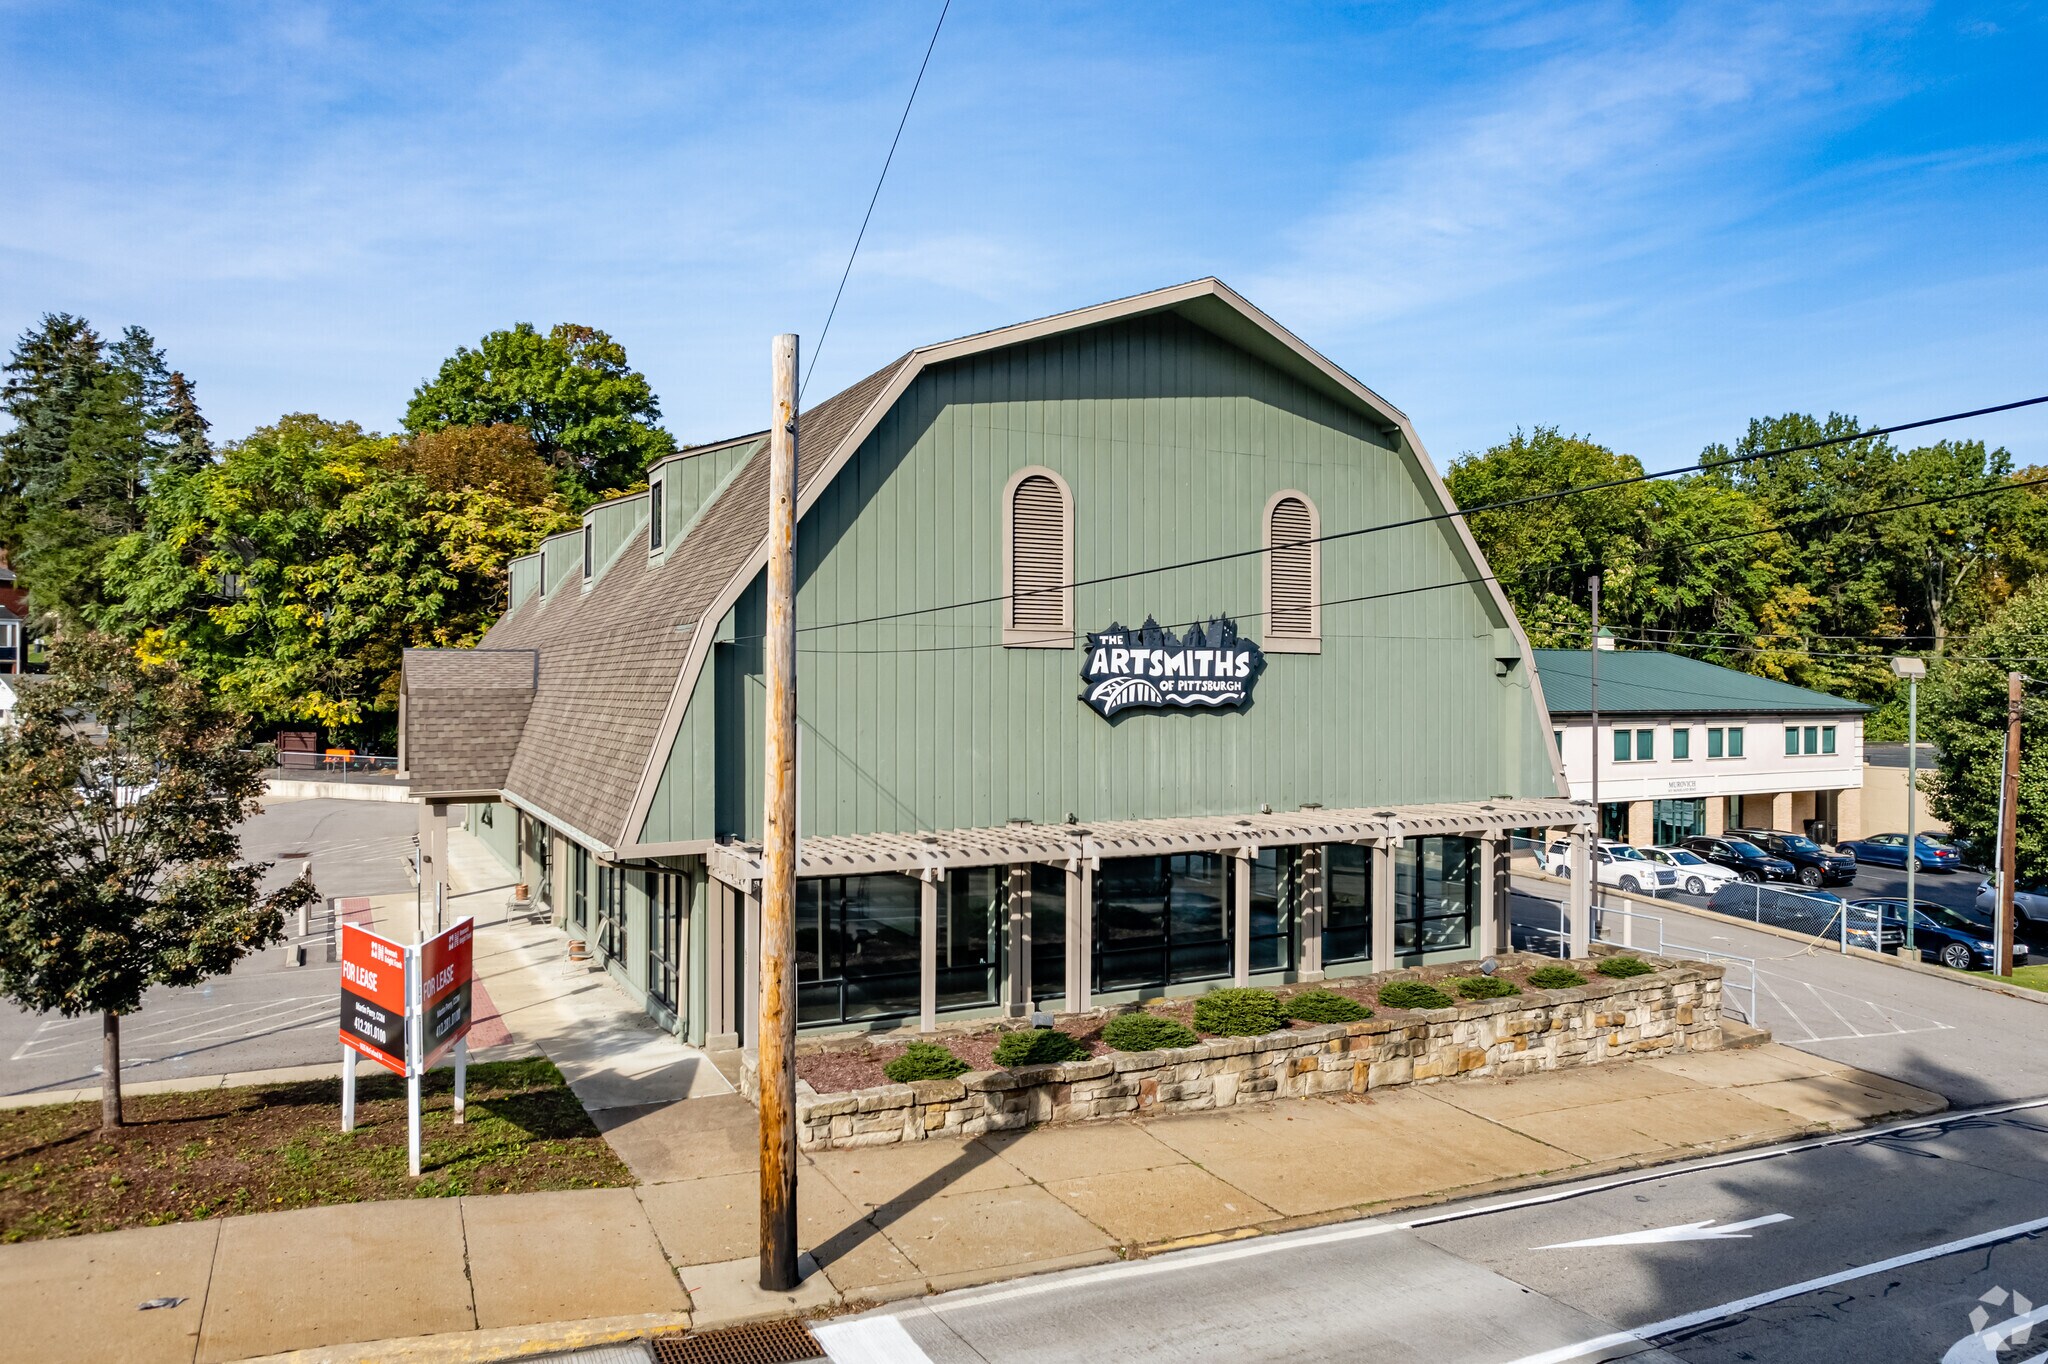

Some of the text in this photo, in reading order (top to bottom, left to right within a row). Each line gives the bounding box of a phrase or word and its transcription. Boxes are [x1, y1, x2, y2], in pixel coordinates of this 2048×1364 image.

[1099, 635, 1124, 644] THE
[1090, 648, 1250, 677] ARTSMITHS
[1160, 680, 1242, 692] OF PITTSBURGH
[343, 960, 378, 992] FOR LEASE
[423, 964, 454, 1002] FOR LEASE
[354, 1016, 386, 1044] 412.281.0100
